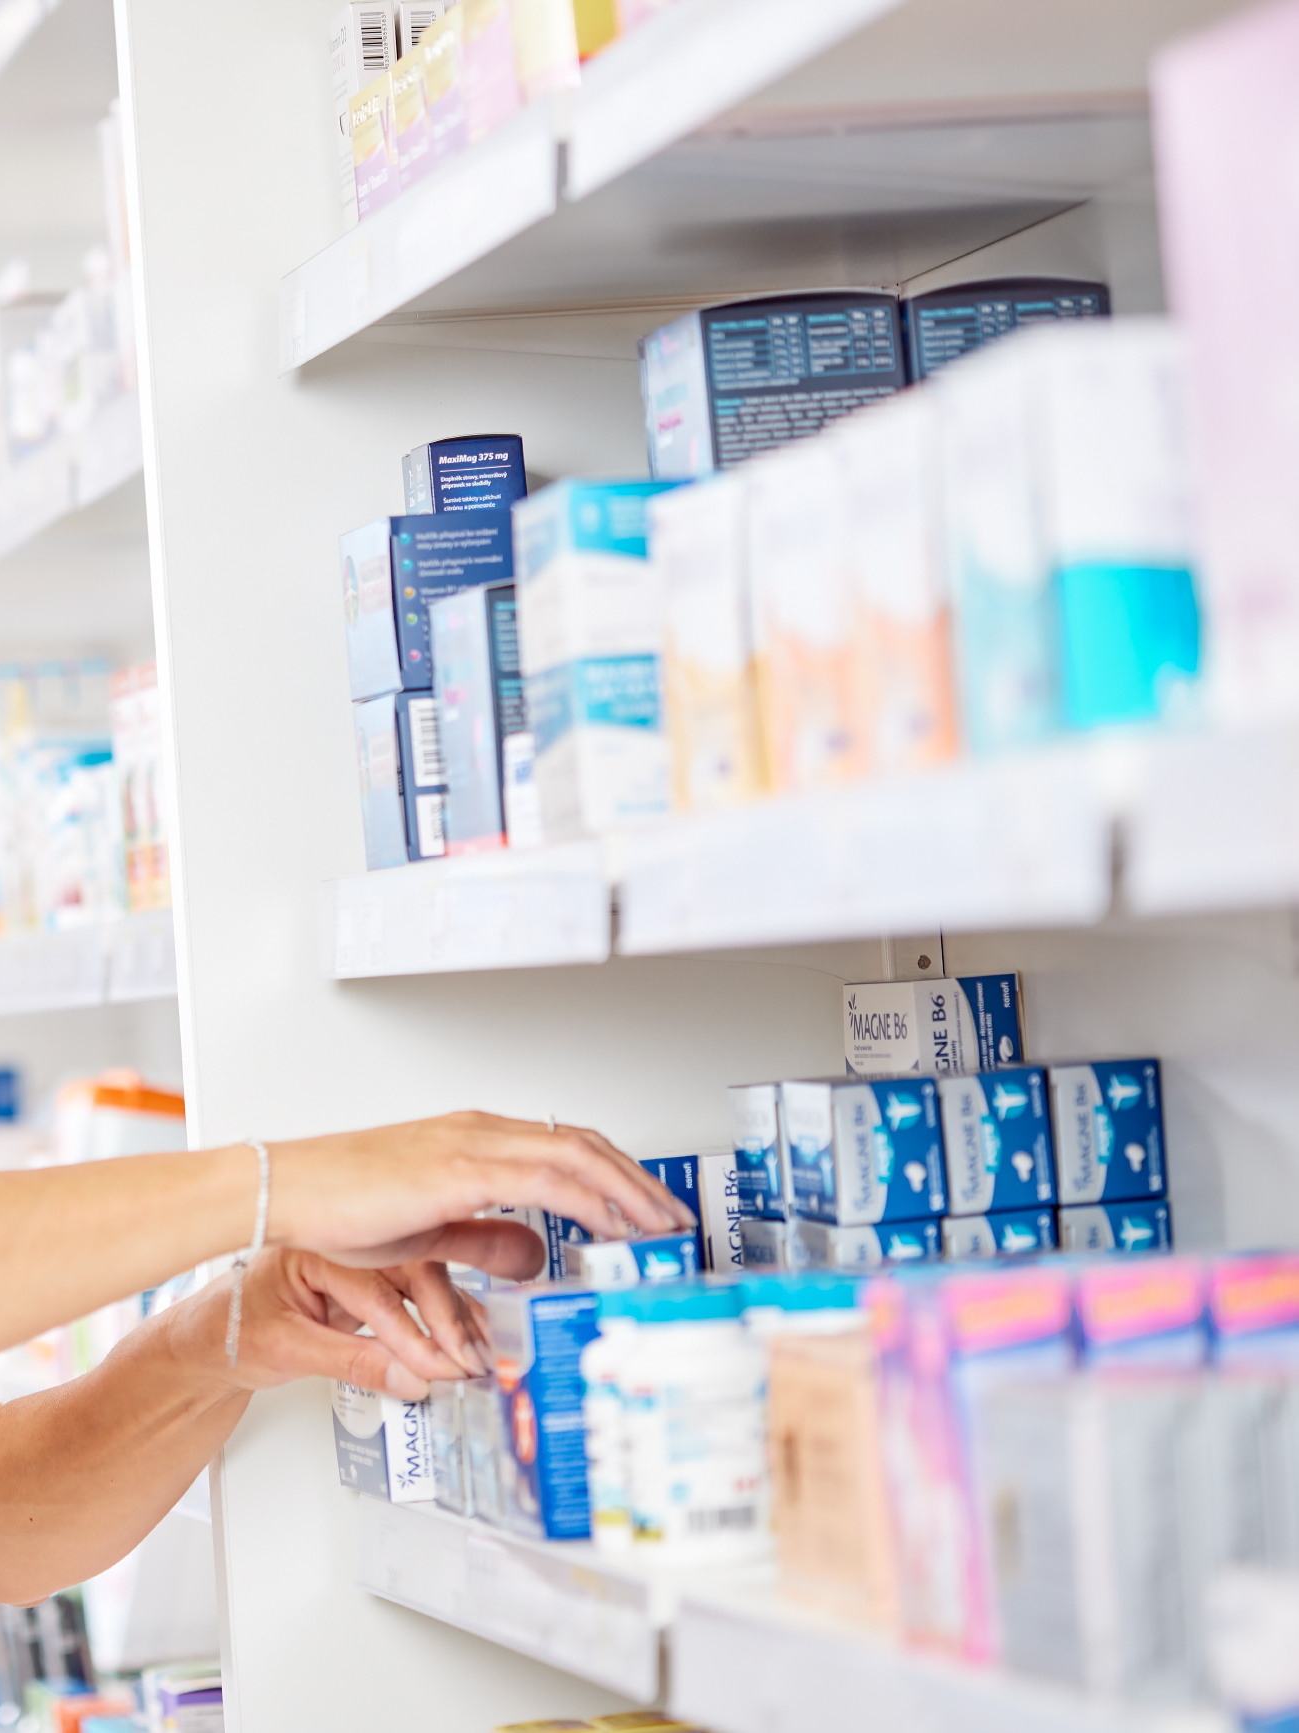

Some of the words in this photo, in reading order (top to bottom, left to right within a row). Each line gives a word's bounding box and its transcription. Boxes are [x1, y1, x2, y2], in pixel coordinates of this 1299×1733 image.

[438, 454, 477, 464] MaxiMag
[478, 452, 494, 461] 375
[495, 452, 509, 461] mg
[931, 993, 947, 1022] B6
[1000, 981, 1010, 1009] sanofi
[853, 1013, 892, 1041] MAGNE
[894, 1012, 909, 1040] B6
[933, 1029, 951, 1071] GNE
[682, 1162, 693, 1189] sanofi
[724, 1169, 739, 1197] B6
[726, 1206, 744, 1268] AGNE
[403, 1400, 421, 1478] MAGN
